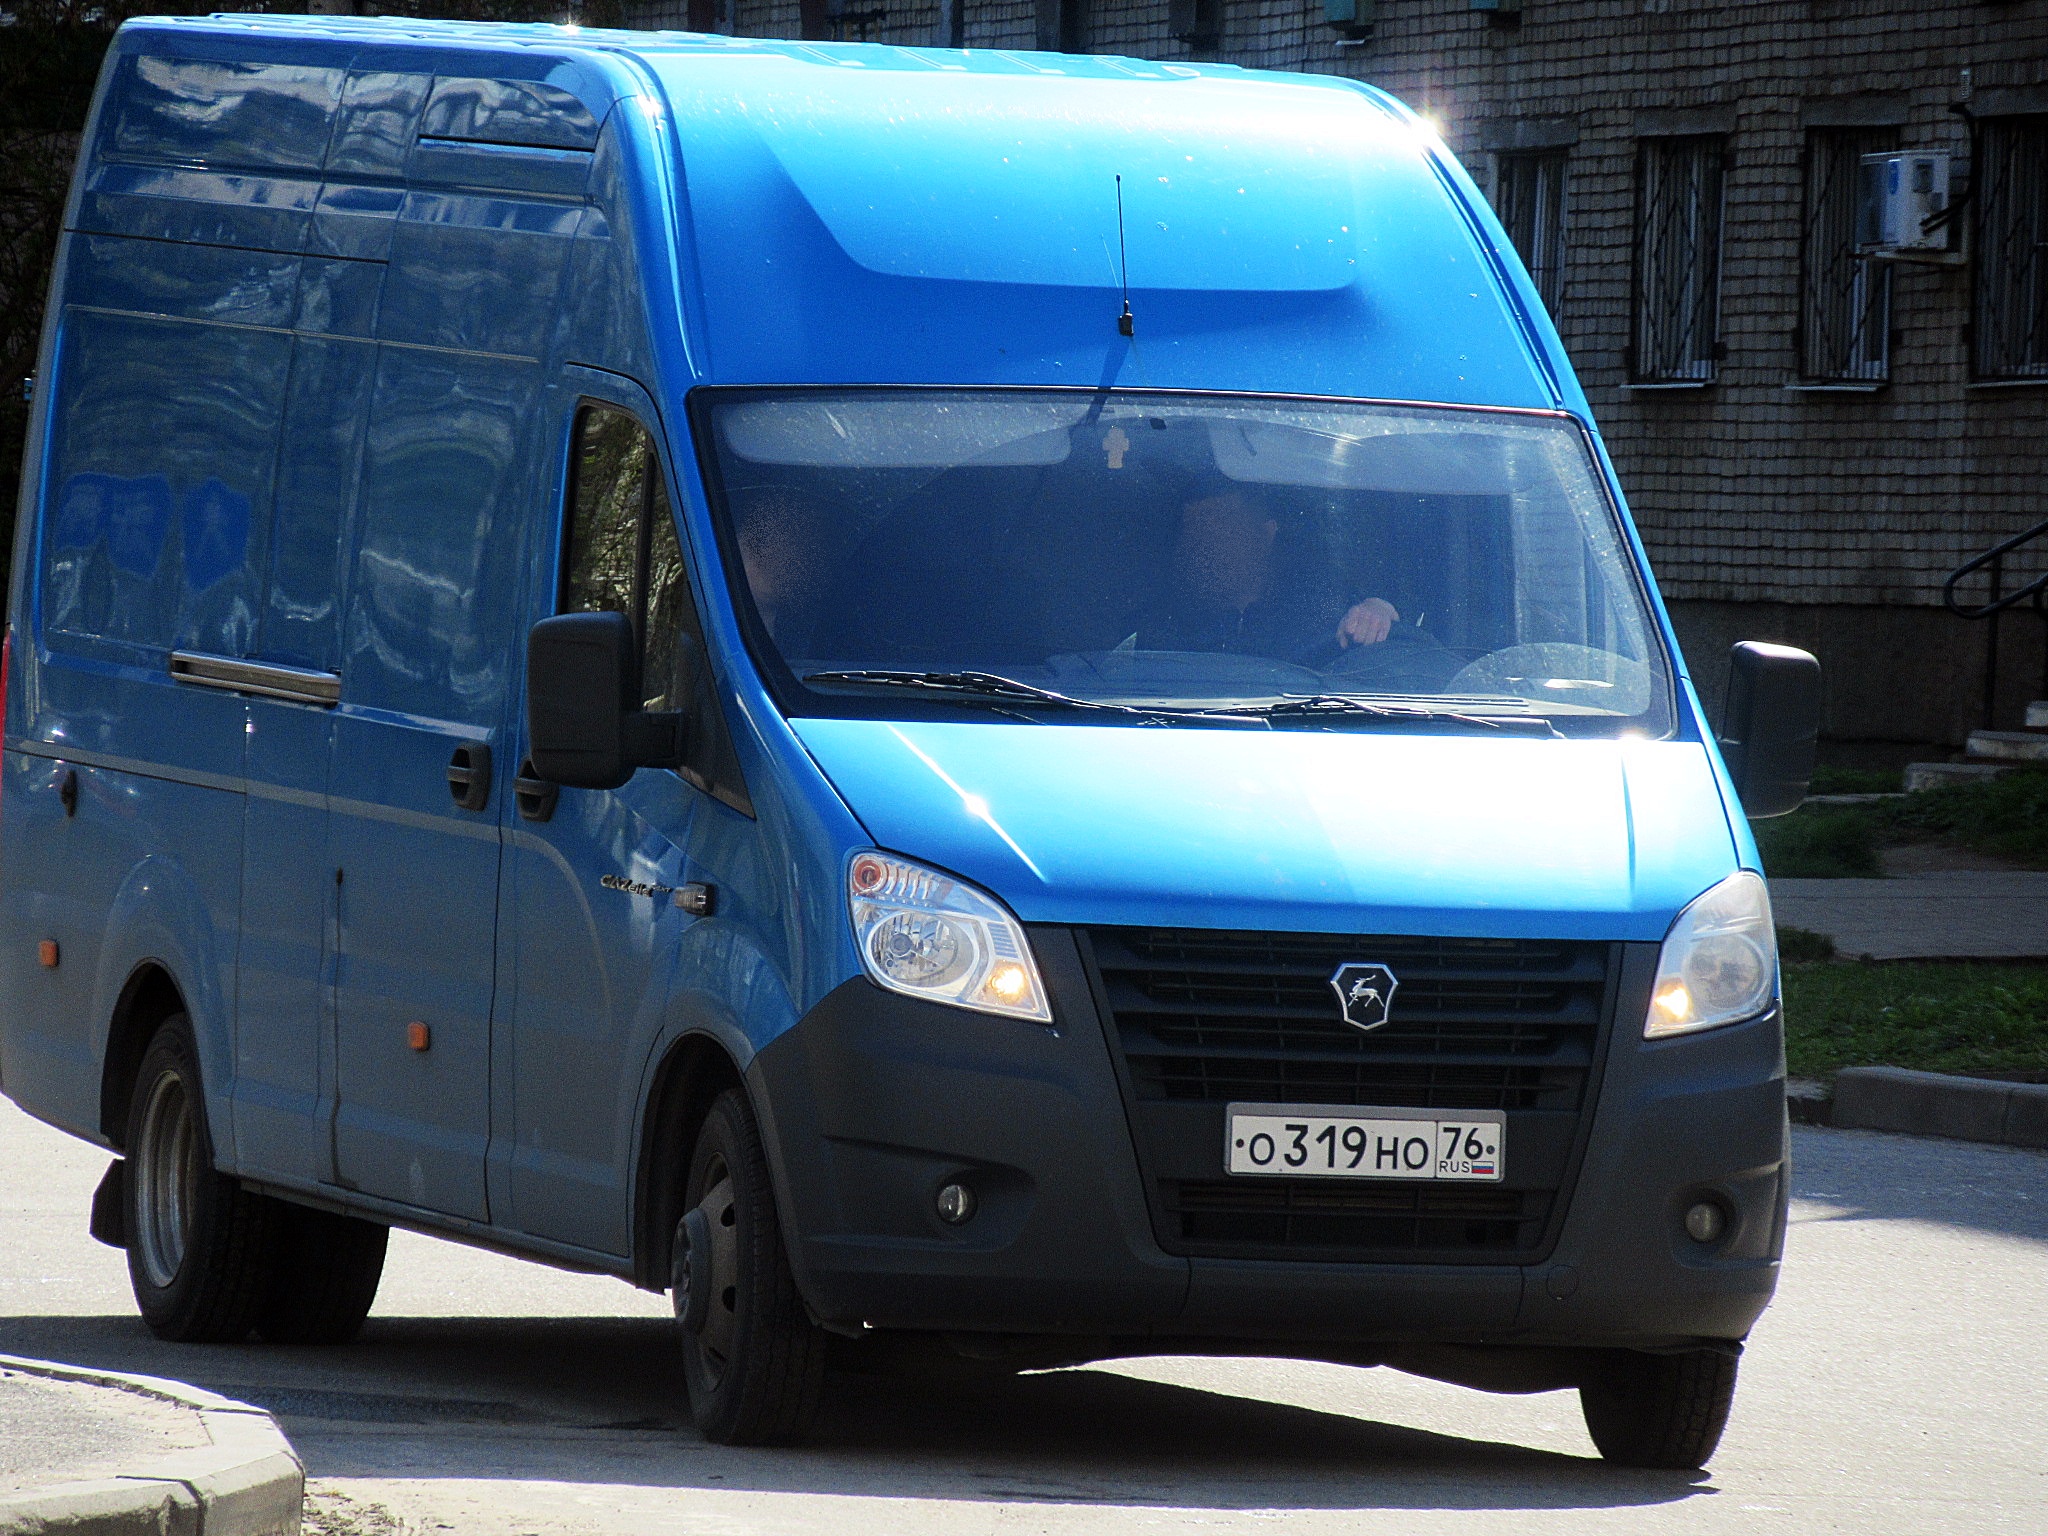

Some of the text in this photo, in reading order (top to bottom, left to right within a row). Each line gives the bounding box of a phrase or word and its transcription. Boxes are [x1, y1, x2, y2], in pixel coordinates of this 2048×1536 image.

[1248, 1124, 1484, 1170] O319HO 76
[1439, 1160, 1470, 1174] RUS
